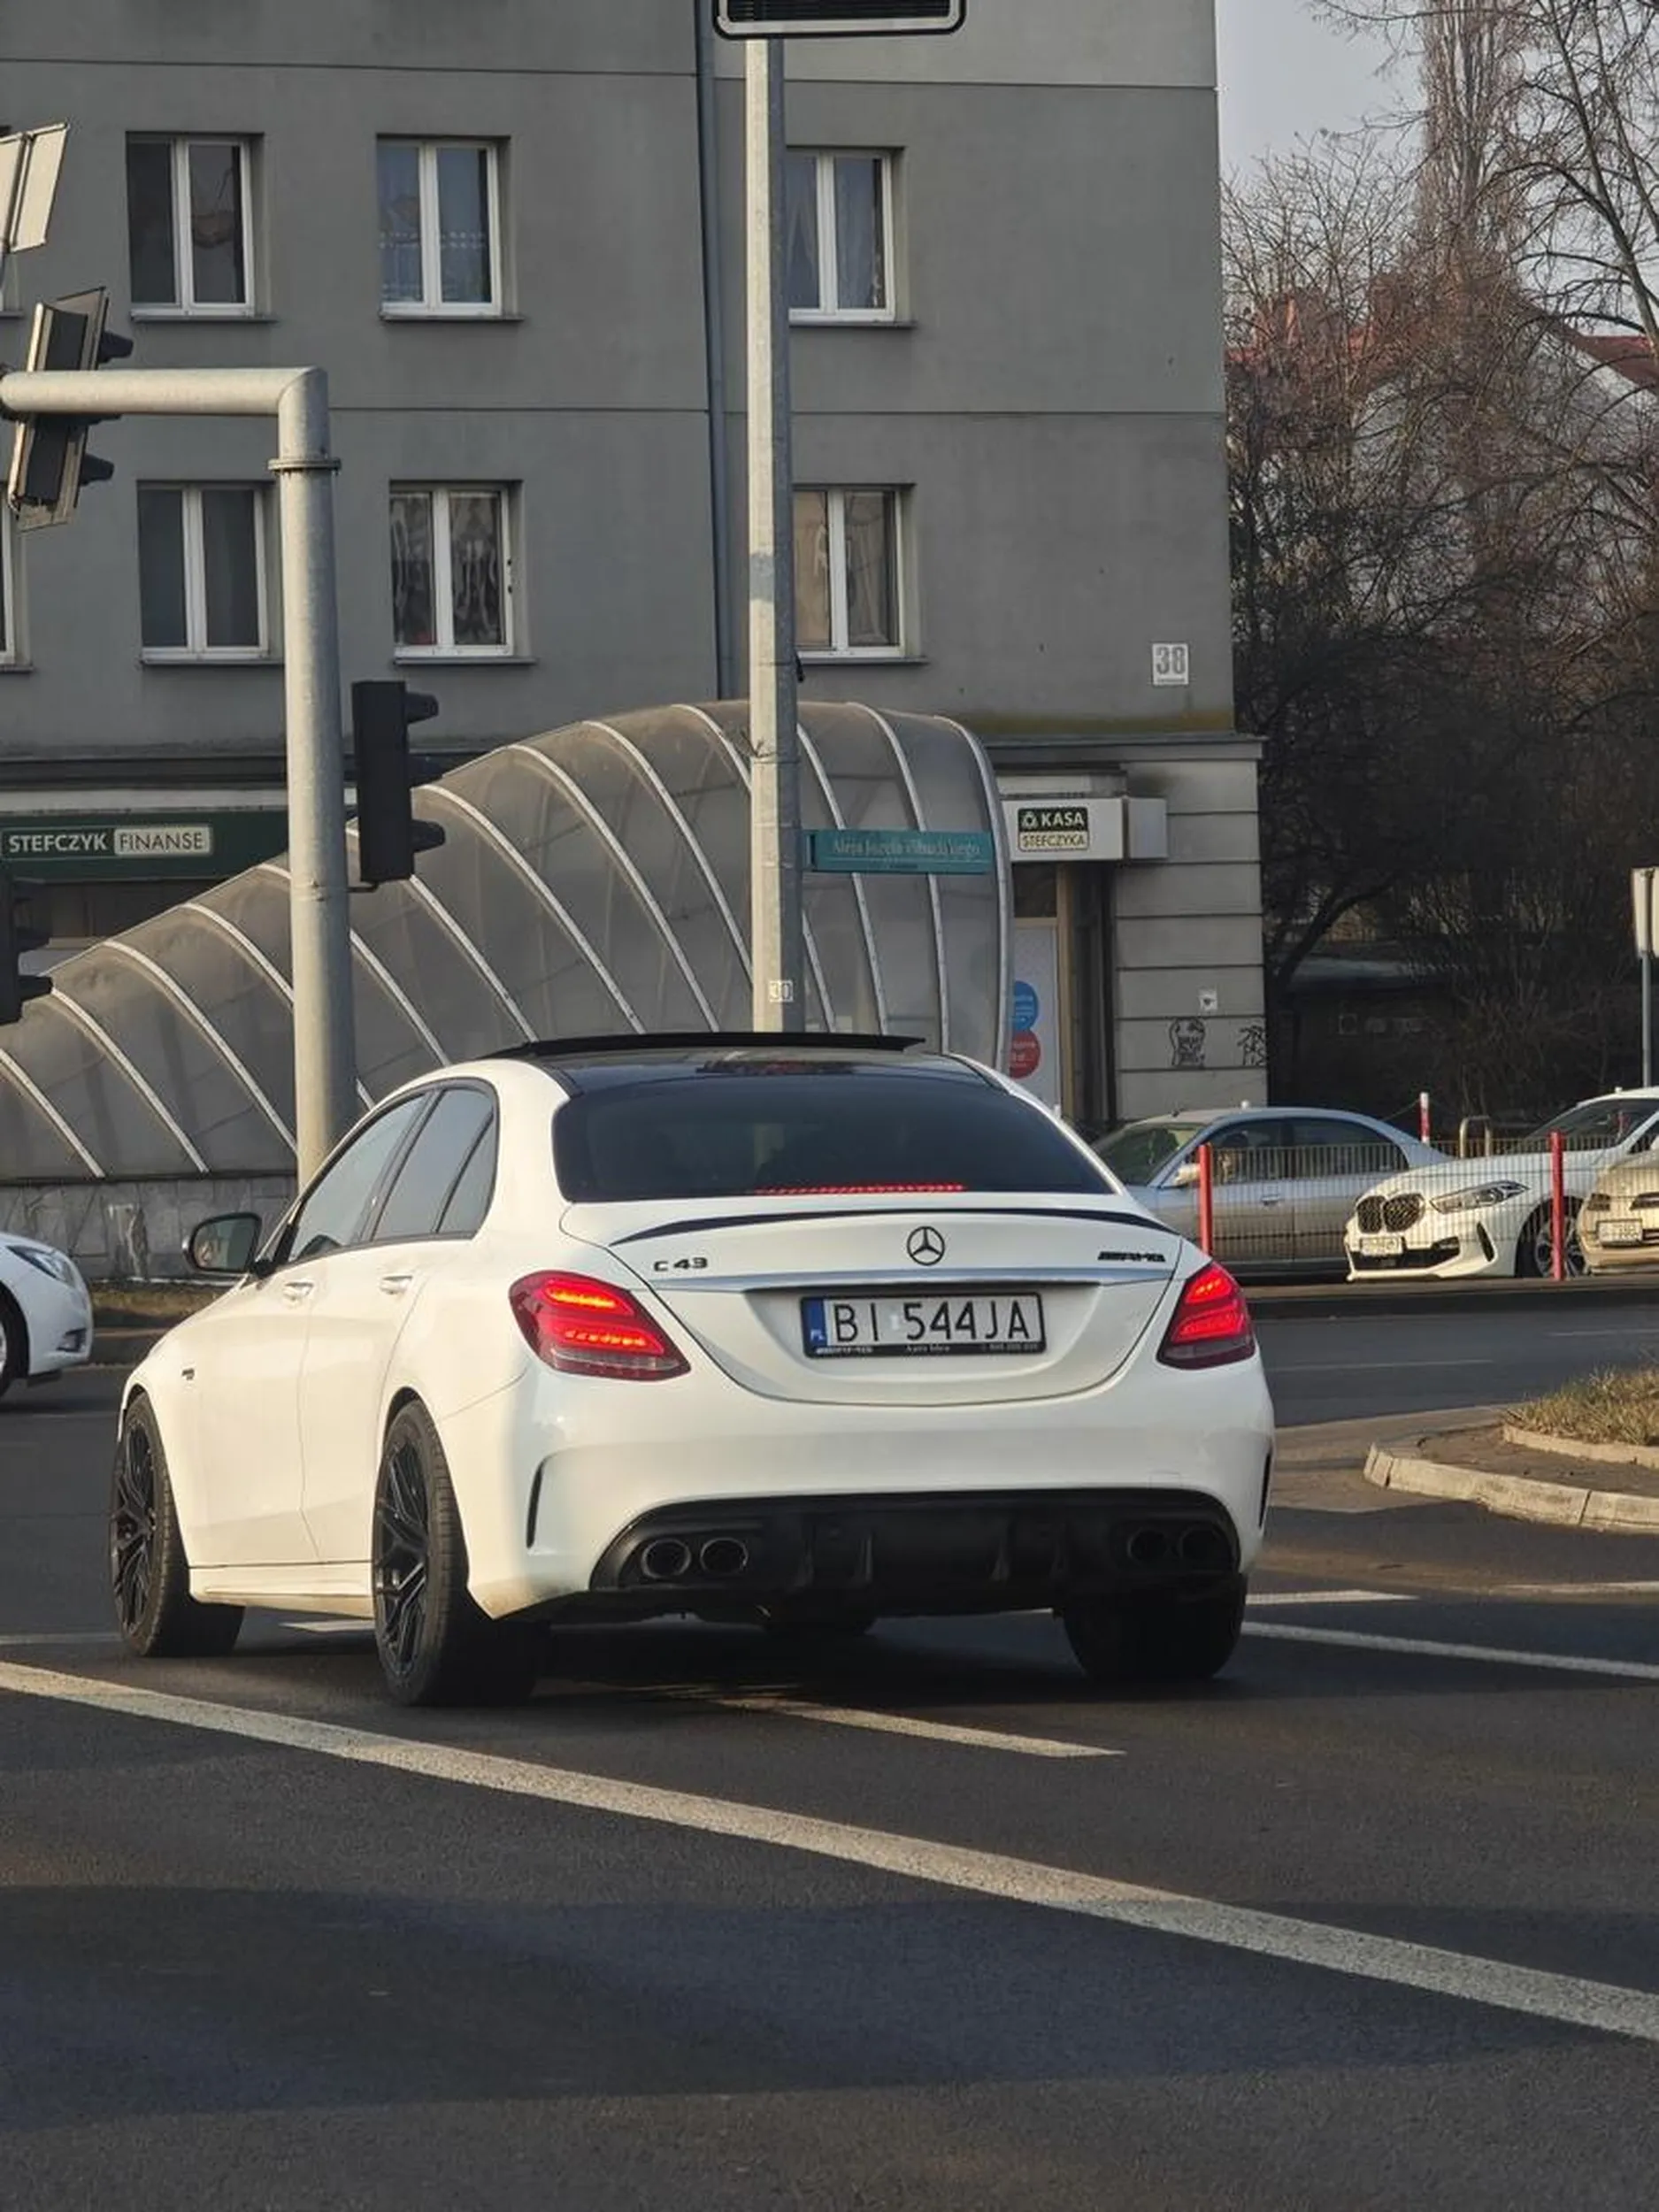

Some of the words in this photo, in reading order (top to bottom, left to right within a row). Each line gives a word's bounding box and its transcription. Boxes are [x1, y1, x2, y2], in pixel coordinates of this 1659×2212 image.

[1155, 646, 1187, 674] 38
[1041, 811, 1085, 827] KASA
[9, 834, 108, 853] STEFCZYK
[119, 832, 204, 851] FINANSE
[1022, 833, 1085, 848] STEFCZYKA
[654, 1261, 669, 1271] C
[673, 1256, 708, 1270] 43
[833, 1302, 879, 1342] BI
[903, 1299, 1030, 1341] 544JA
